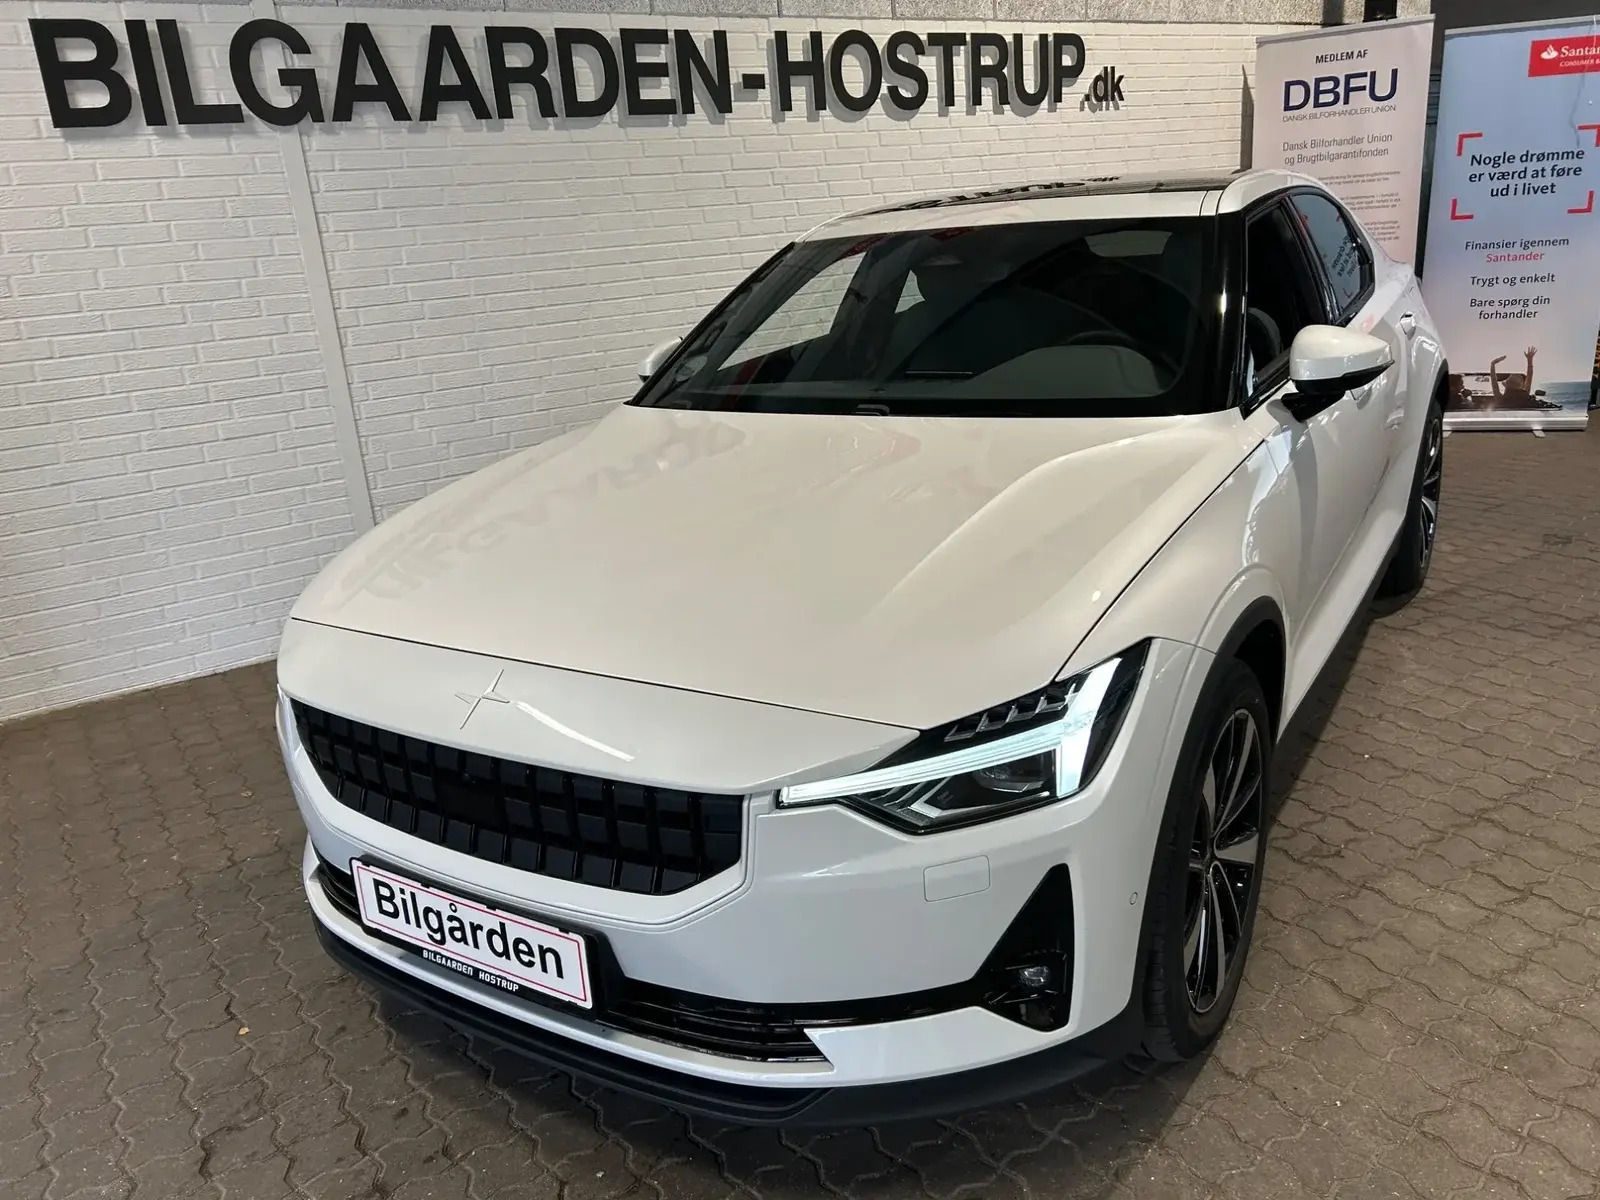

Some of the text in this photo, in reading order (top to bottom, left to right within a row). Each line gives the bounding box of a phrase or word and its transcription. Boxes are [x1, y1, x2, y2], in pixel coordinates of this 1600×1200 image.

[1315, 49, 1368, 64] MEDLEM AF
[1283, 68, 1398, 112] DBFU
[1282, 104, 1396, 123] DANSK BILFORHANDLER UNION
[1282, 133, 1392, 152] Dansk Bilforhandler Union
[1284, 147, 1389, 166] og Brugtbilgarantifonden
[1470, 149, 1585, 169] Nogle drømme
[1468, 164, 1582, 182] er værd at føre
[1490, 182, 1556, 197] ud i livet
[1465, 238, 1569, 251] Finansier igennem
[1486, 251, 1545, 263] Santander
[1470, 273, 1555, 287] Trygt og enkelt
[1469, 296, 1550, 308] Bare spørg din
[1479, 309, 1538, 320] forhandler
[372, 877, 565, 980] Bilgården
[422, 949, 519, 993] BILGAARDEN HOSTRUP
